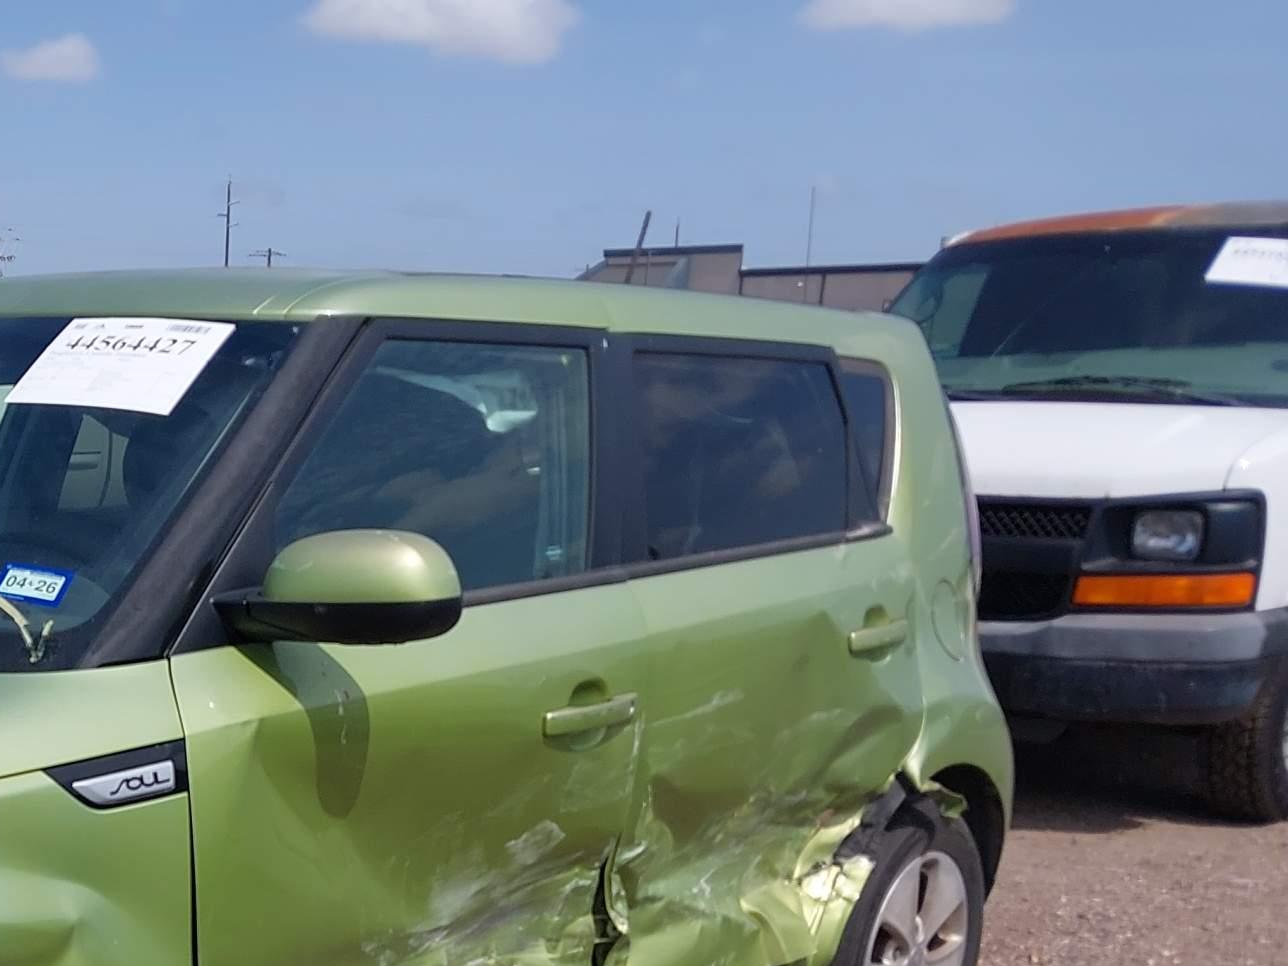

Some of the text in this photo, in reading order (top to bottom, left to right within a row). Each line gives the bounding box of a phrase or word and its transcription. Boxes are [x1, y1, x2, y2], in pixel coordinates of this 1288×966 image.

[65, 335, 197, 355] 44564427
[5, 575, 58, 594] 04 26
